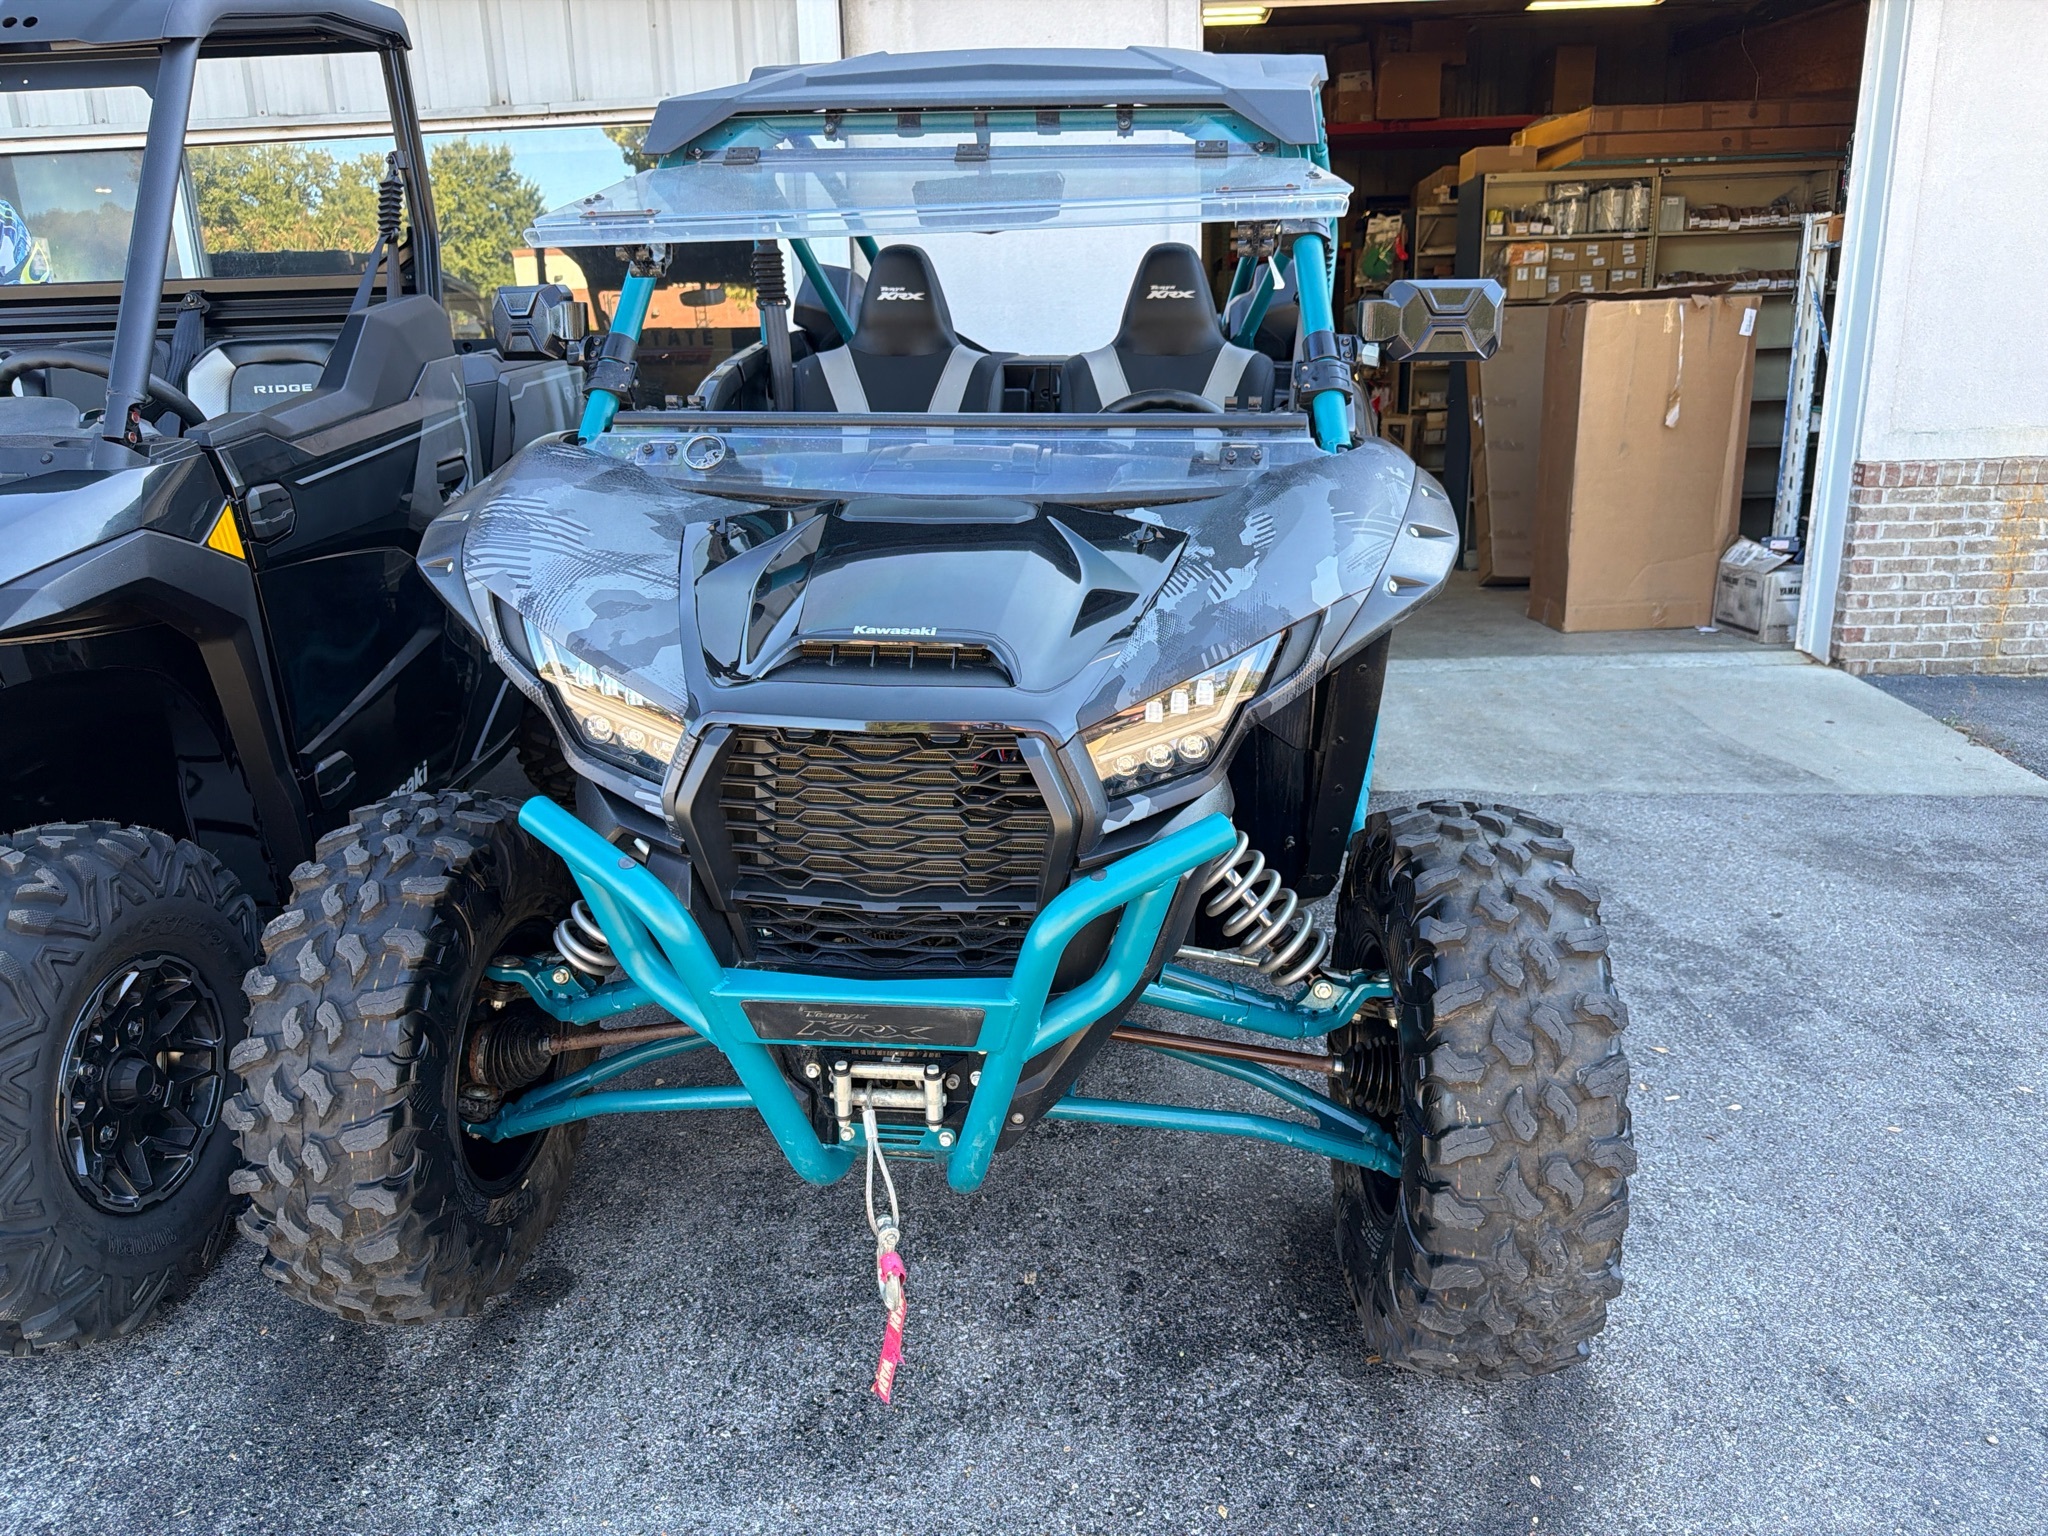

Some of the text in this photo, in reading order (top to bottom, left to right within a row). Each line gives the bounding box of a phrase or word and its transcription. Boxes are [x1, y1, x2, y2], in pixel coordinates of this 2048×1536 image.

[876, 291, 926, 301] KRX
[1146, 290, 1196, 299] KRX
[253, 383, 313, 394] RIDGE
[852, 625, 938, 636] Kawasaki
[795, 1020, 935, 1041] KRX
[878, 1358, 895, 1397] WARN
